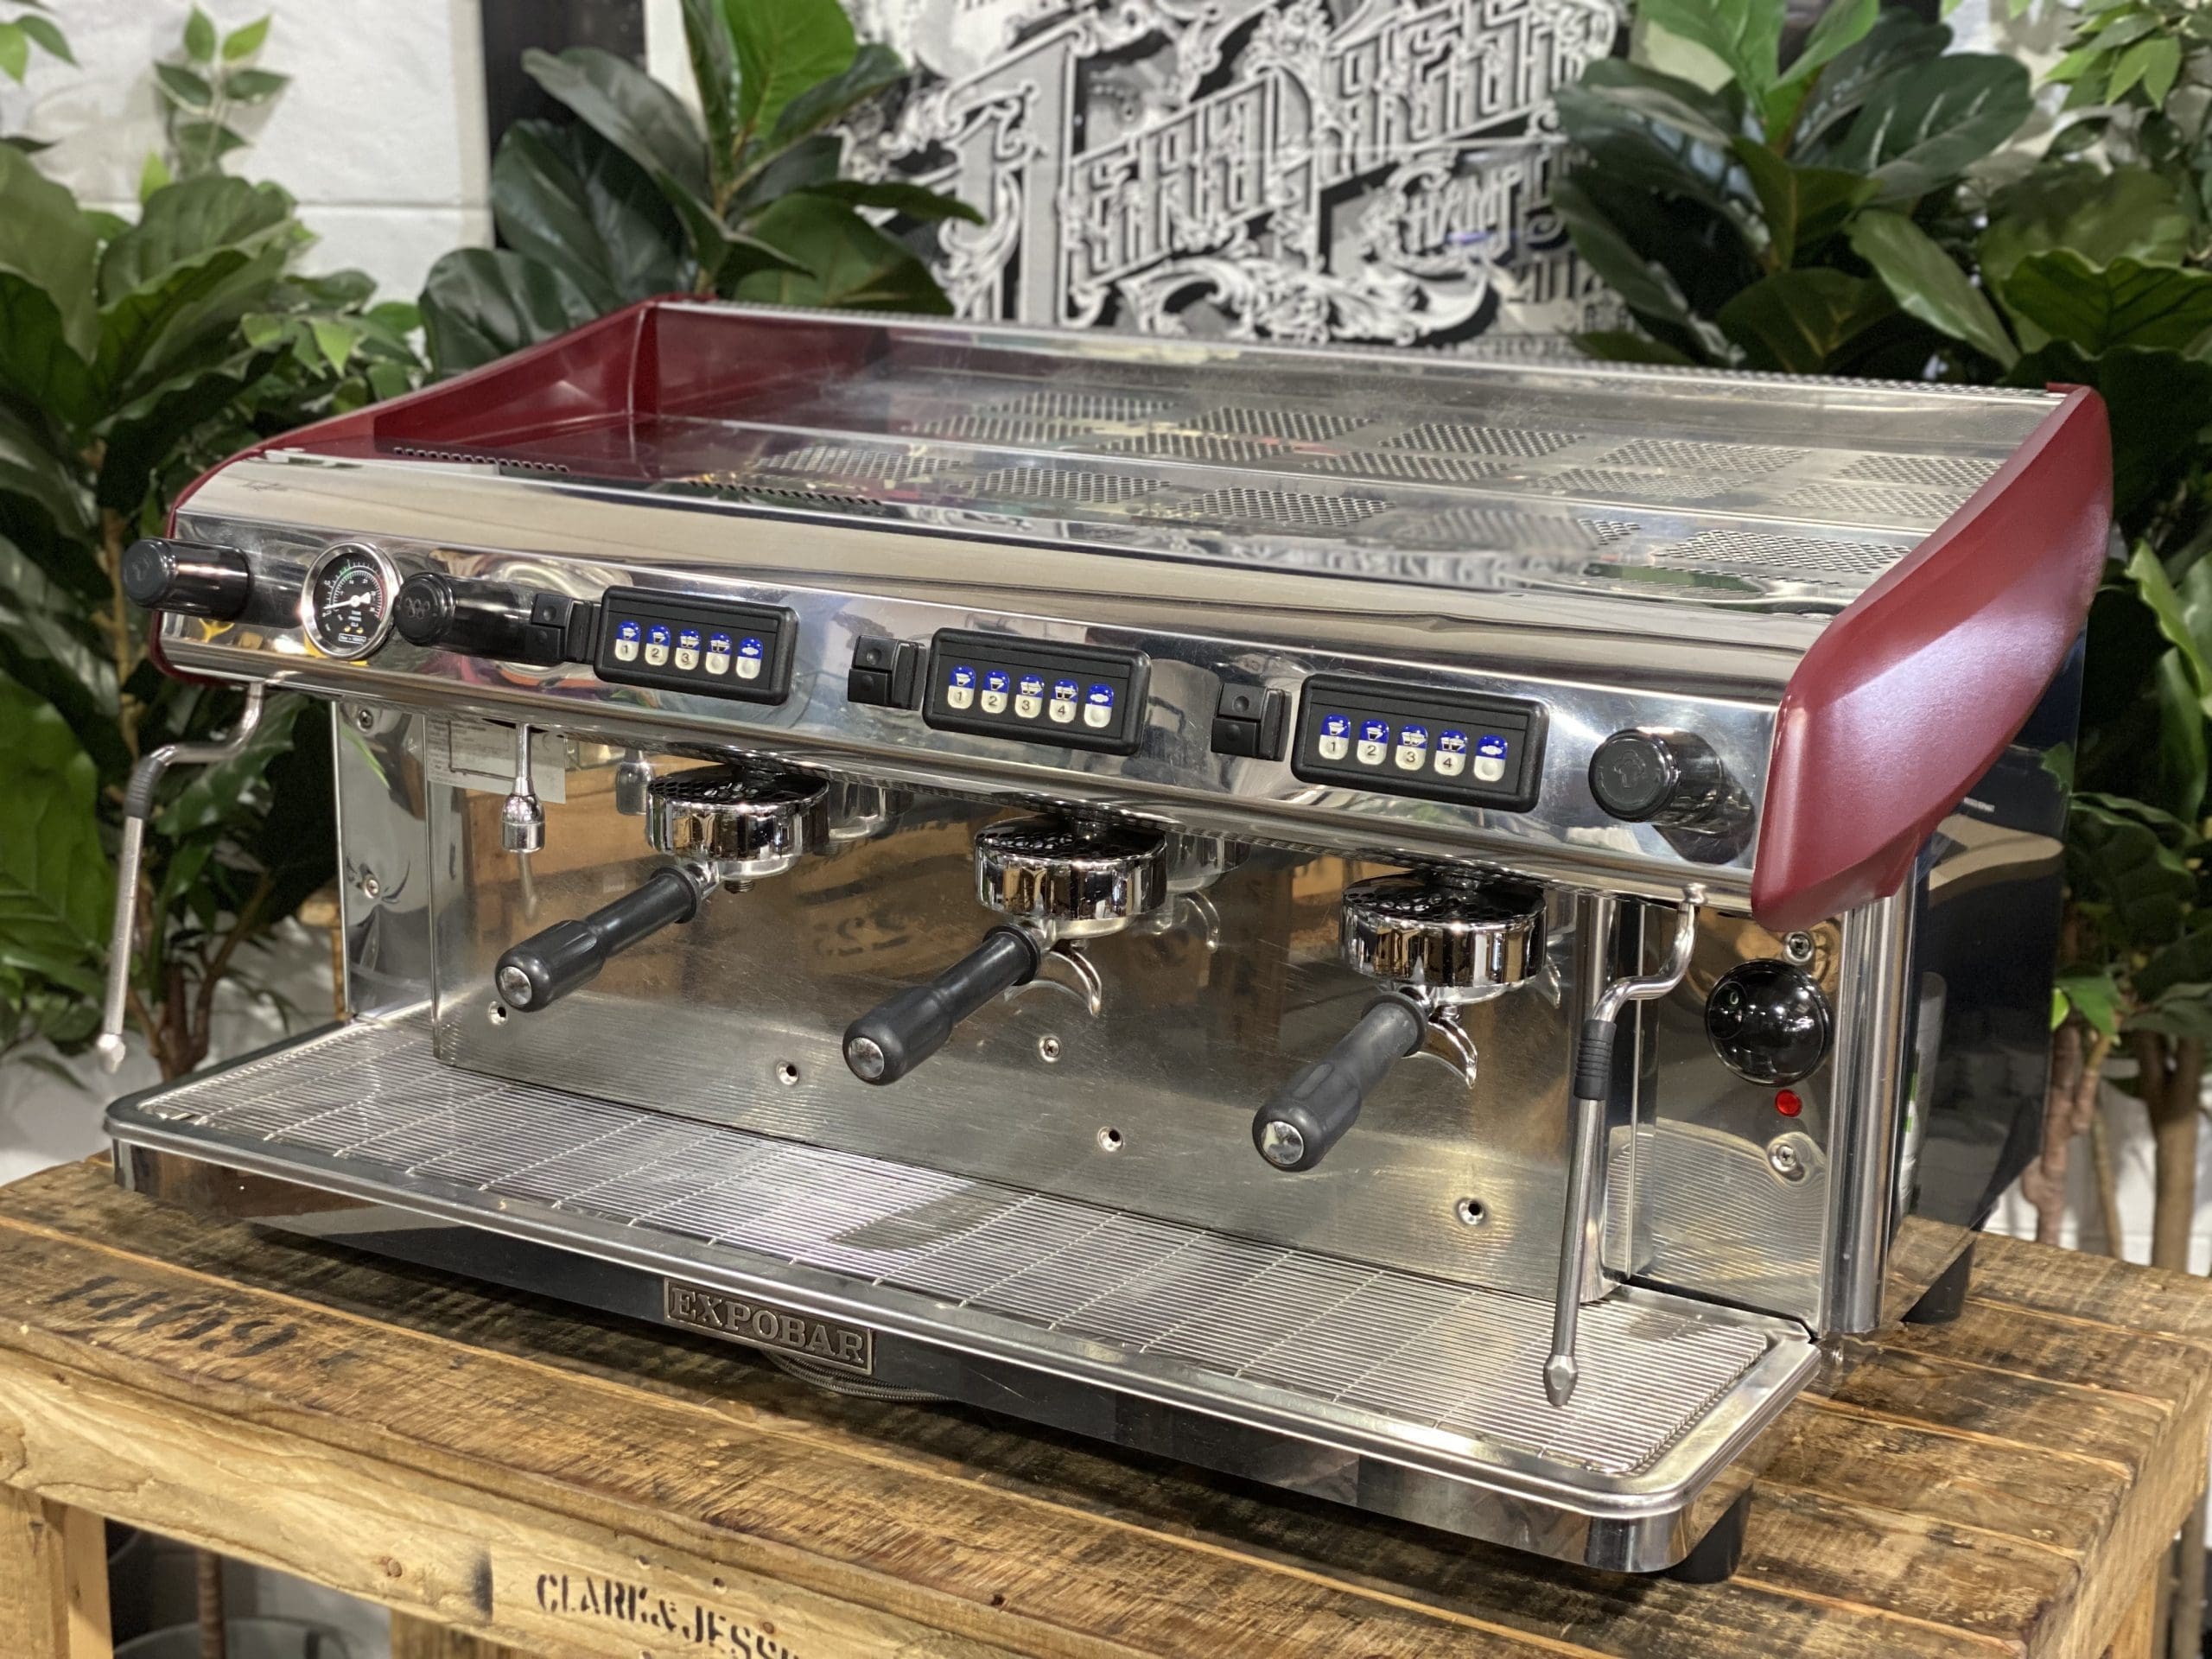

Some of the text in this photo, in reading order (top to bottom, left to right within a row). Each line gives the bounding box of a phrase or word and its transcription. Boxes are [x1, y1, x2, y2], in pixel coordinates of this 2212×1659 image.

[652, 648, 659, 658] 2
[681, 652, 690, 664] 3
[989, 696, 998, 707] 2
[1021, 700, 1031, 712] 3
[1057, 705, 1066, 716] 4
[1367, 745, 1376, 756] 2
[1406, 751, 1415, 763] 3
[1442, 757, 1452, 768] 4
[671, 1287, 865, 1364] EXPOBAR
